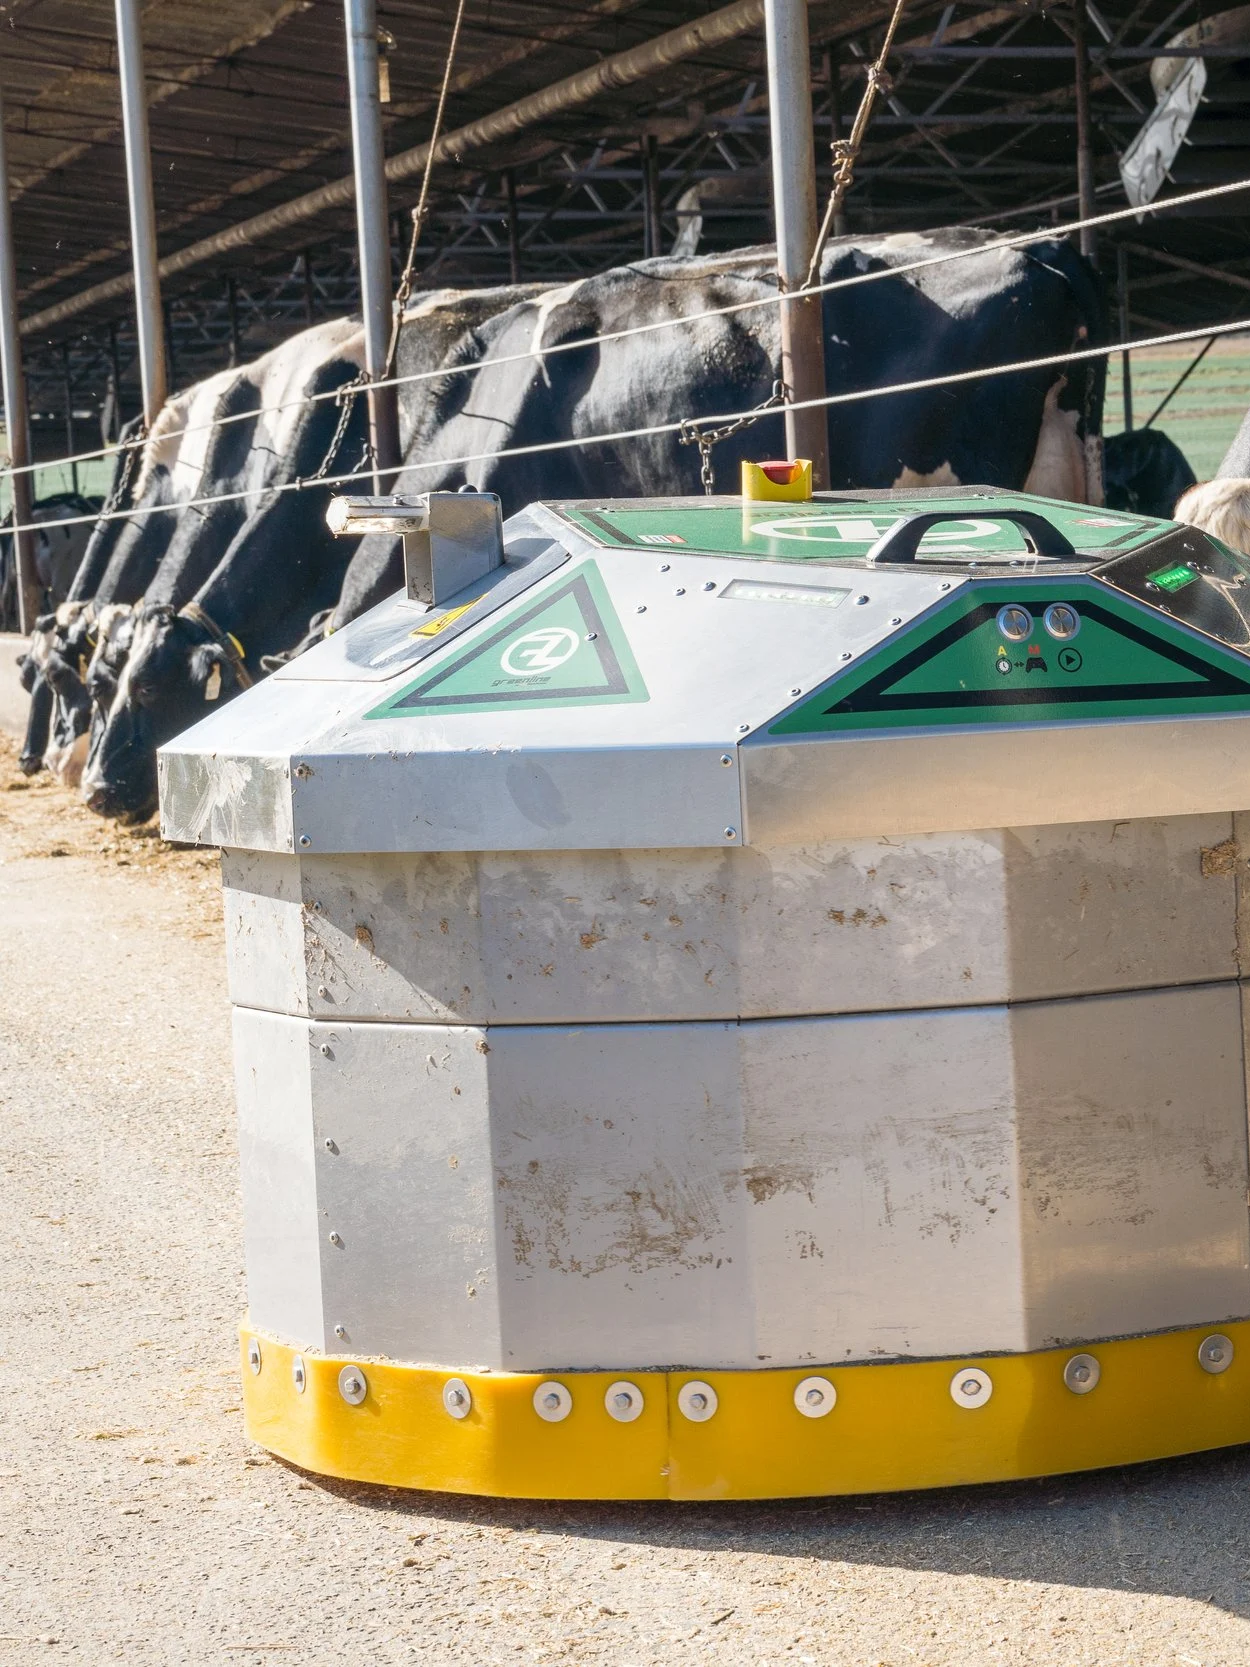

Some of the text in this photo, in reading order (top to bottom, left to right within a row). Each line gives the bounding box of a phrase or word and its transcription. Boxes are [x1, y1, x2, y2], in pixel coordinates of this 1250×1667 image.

[997, 645, 1040, 656] A M
[491, 675, 552, 687] greenline
